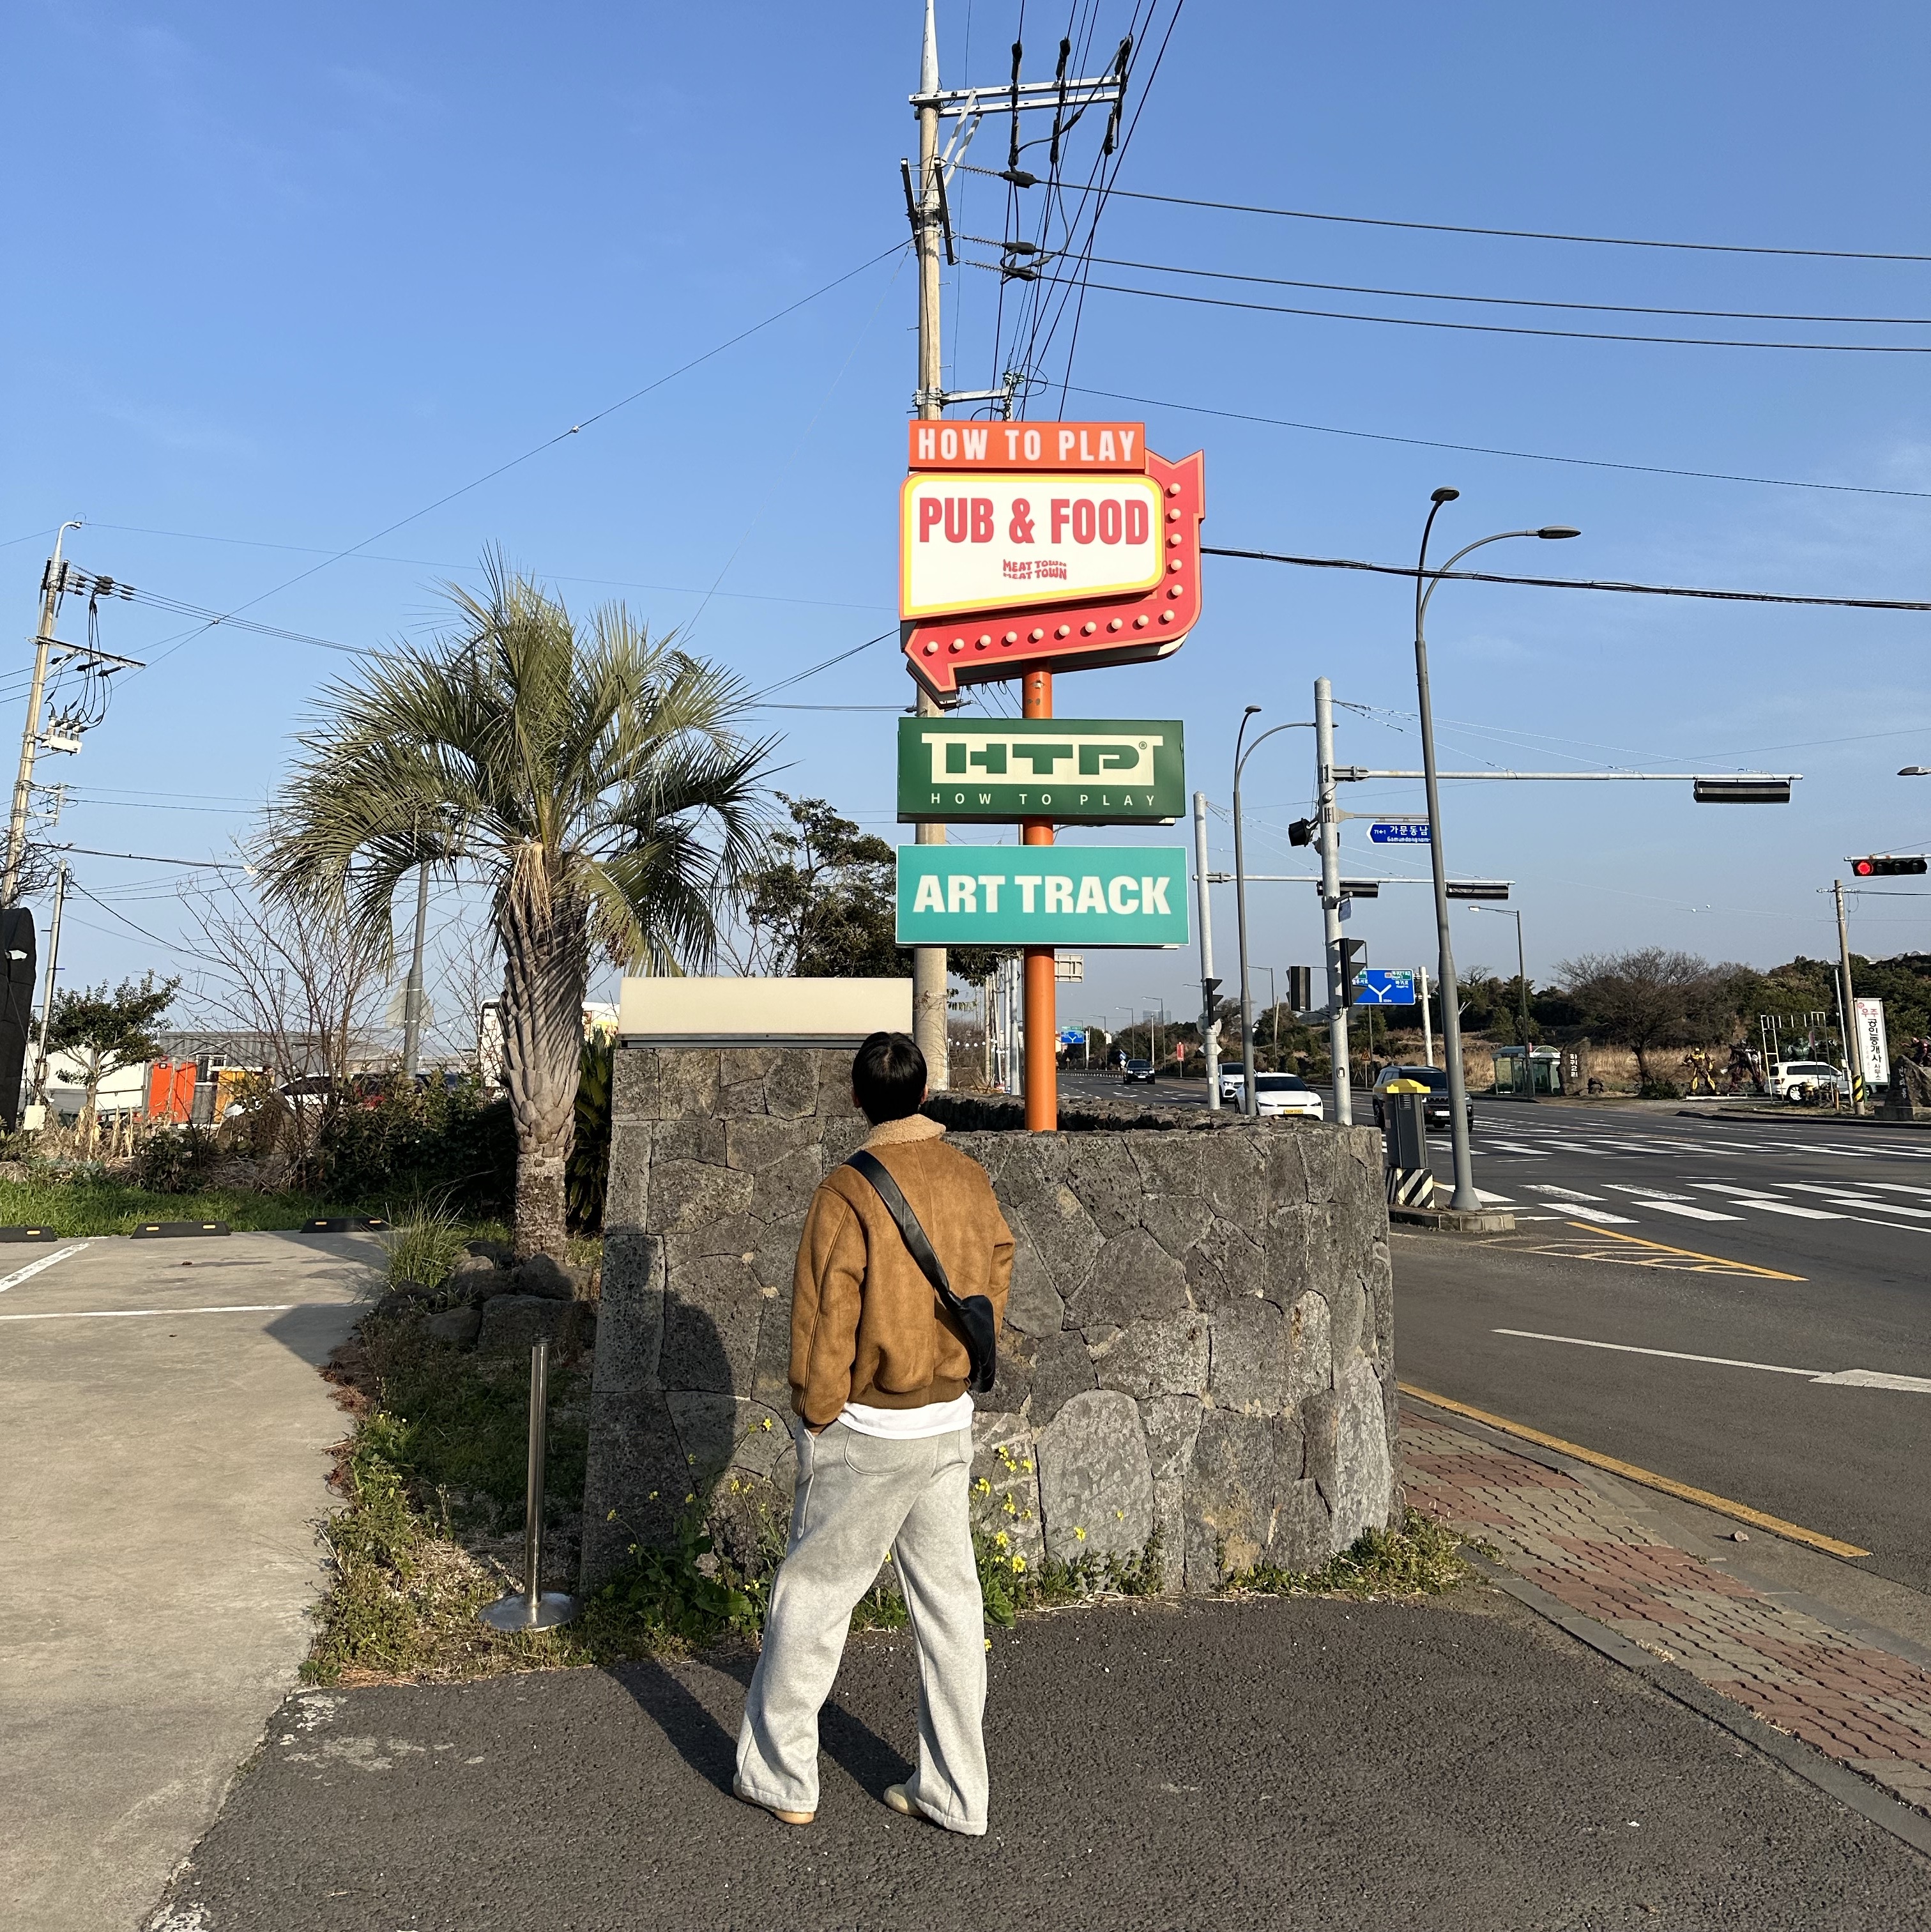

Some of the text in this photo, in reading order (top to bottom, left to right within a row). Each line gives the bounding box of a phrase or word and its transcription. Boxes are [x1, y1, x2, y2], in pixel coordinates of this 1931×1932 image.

[918, 428, 1135, 462] HOW TO PLAY
[919, 497, 1149, 545] PUB & FOOD
[1002, 559, 1067, 572] MEAT TOWN
[1003, 567, 1067, 580] MEAT TOWN
[931, 792, 1155, 806] HOW TO PLAY
[912, 875, 1172, 915] ART TRACK
[1861, 1008, 1879, 1017] 우주
